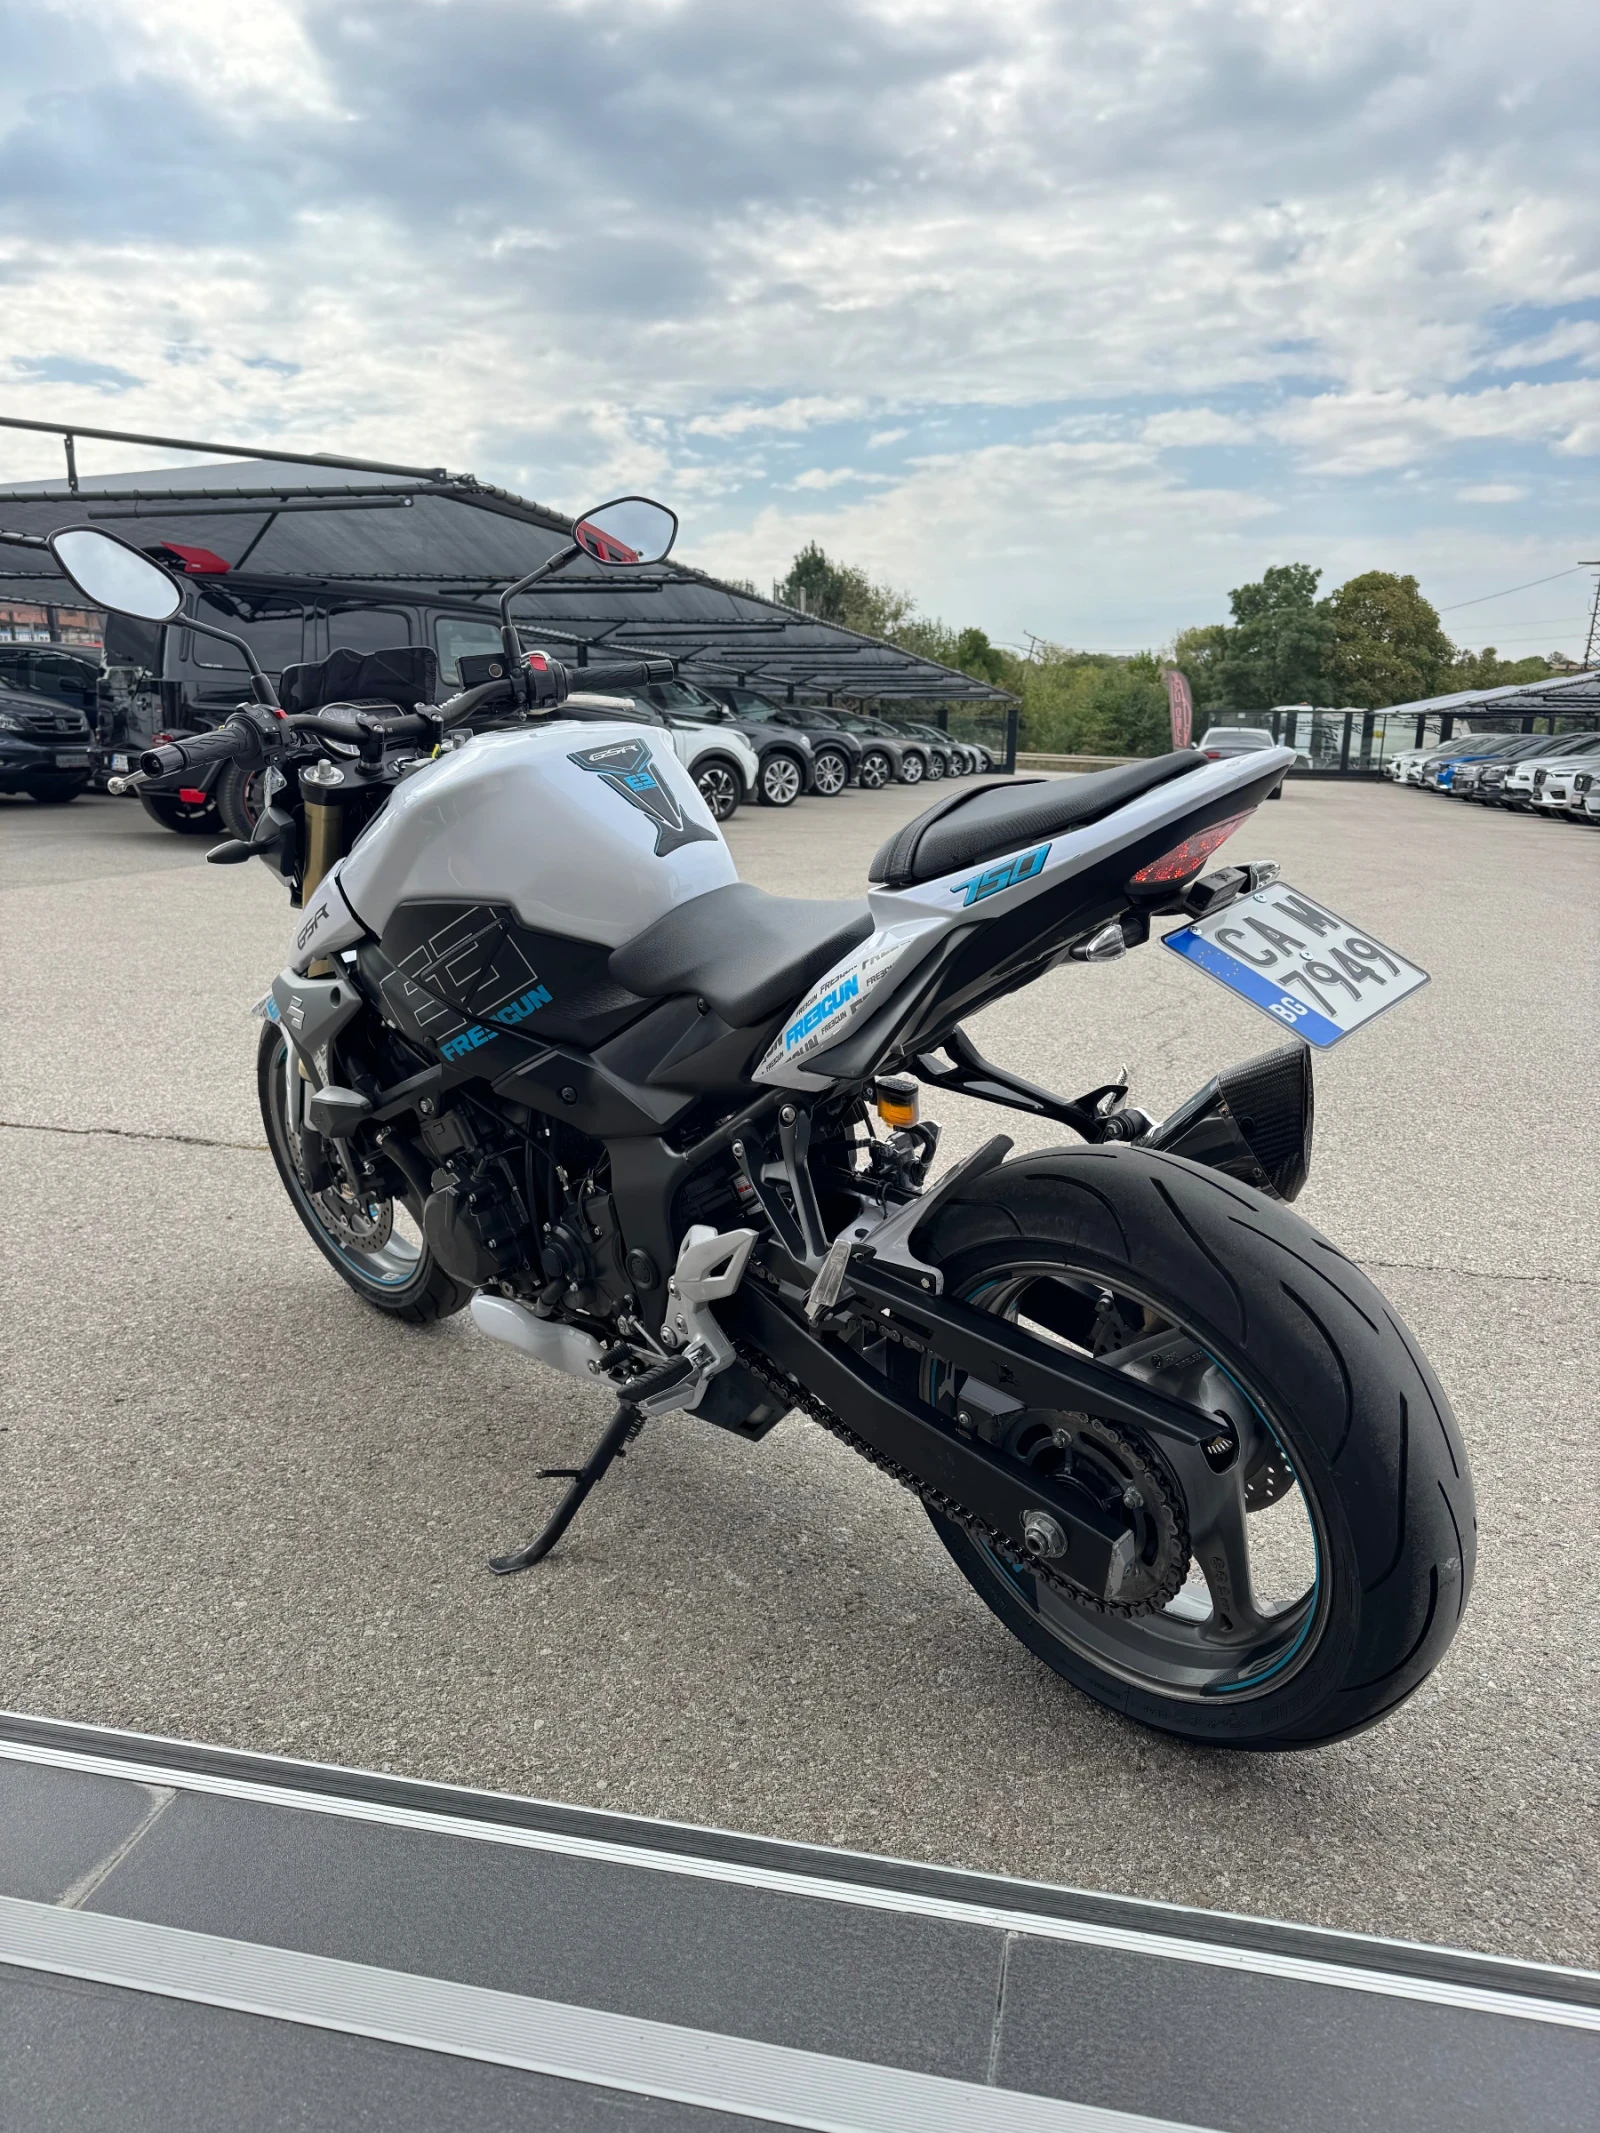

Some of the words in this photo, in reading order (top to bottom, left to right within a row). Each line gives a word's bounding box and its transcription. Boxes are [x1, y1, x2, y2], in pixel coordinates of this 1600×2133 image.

[589, 745, 639, 762] GSR
[950, 843, 1052, 907] 750
[298, 903, 329, 951] GSR
[1214, 916, 1307, 967] CA
[1272, 895, 1341, 937] M
[1276, 938, 1401, 1017] 7949
[1268, 997, 1308, 1023] BG
